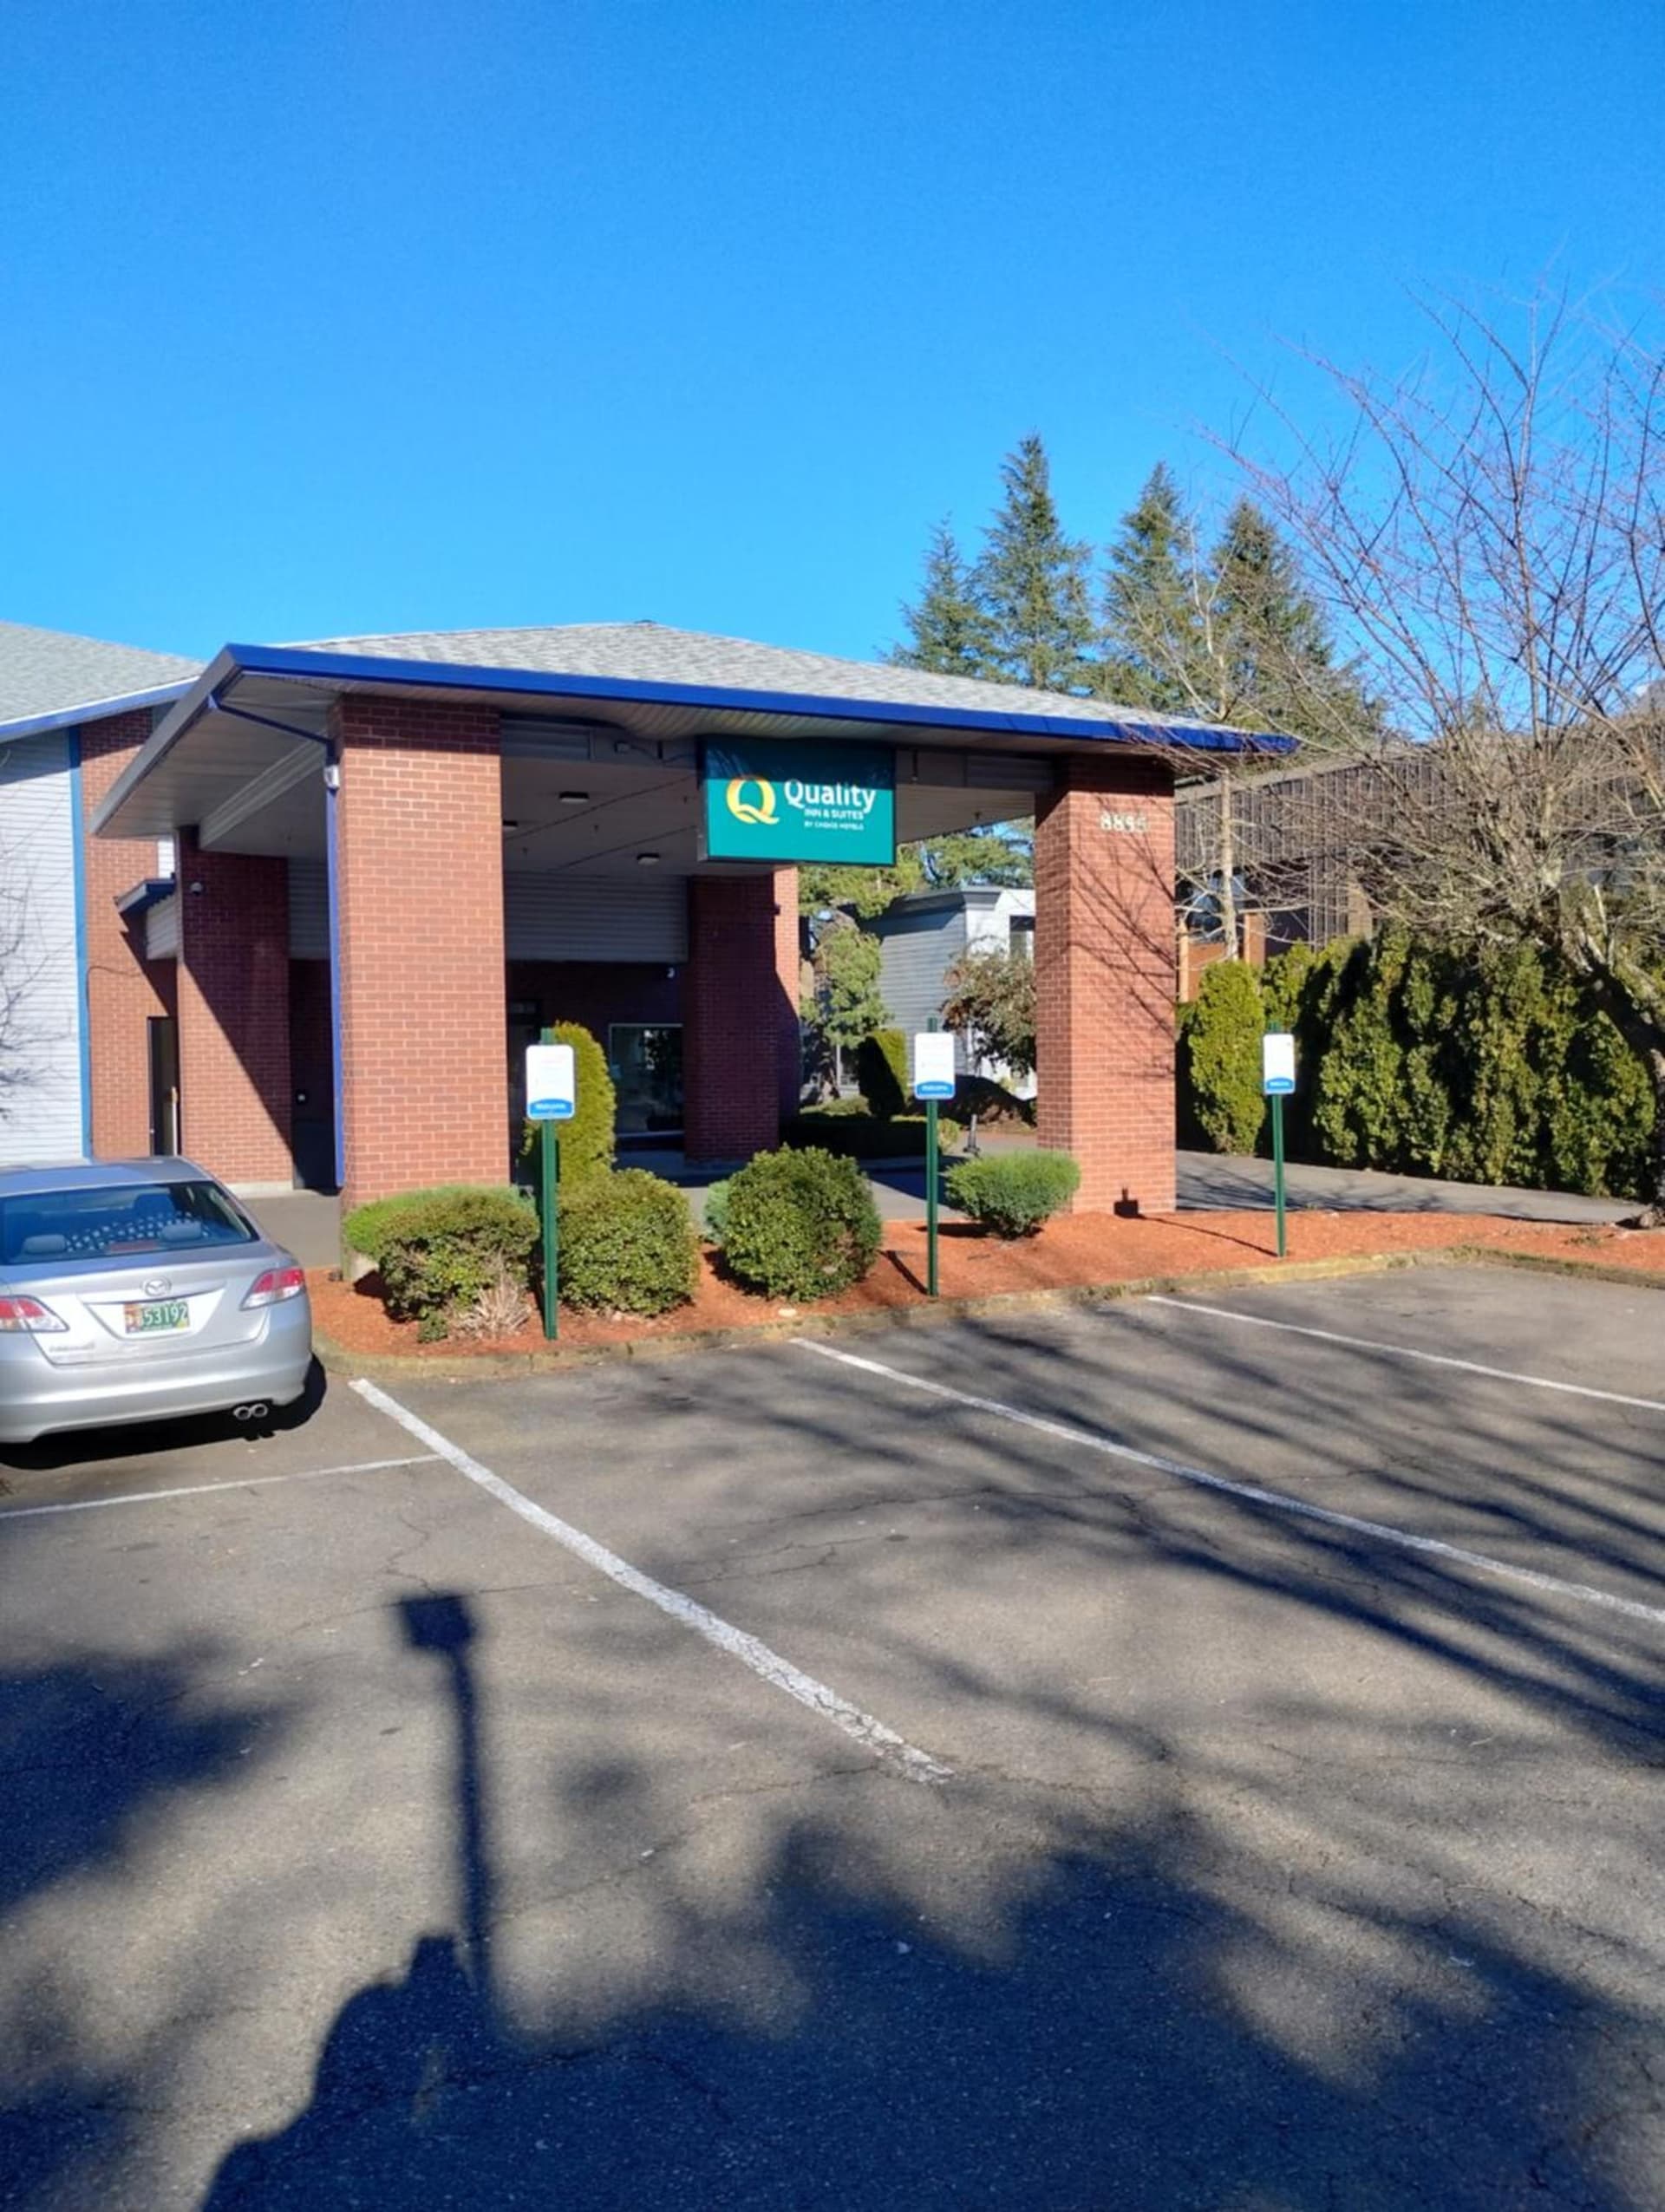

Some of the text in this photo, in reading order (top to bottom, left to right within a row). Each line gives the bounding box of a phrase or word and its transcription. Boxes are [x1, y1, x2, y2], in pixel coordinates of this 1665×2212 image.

[784, 779, 877, 813] Quality
[804, 808, 821, 818] INN
[831, 810, 864, 820] SUITES
[144, 1303, 187, 1326] 53192
